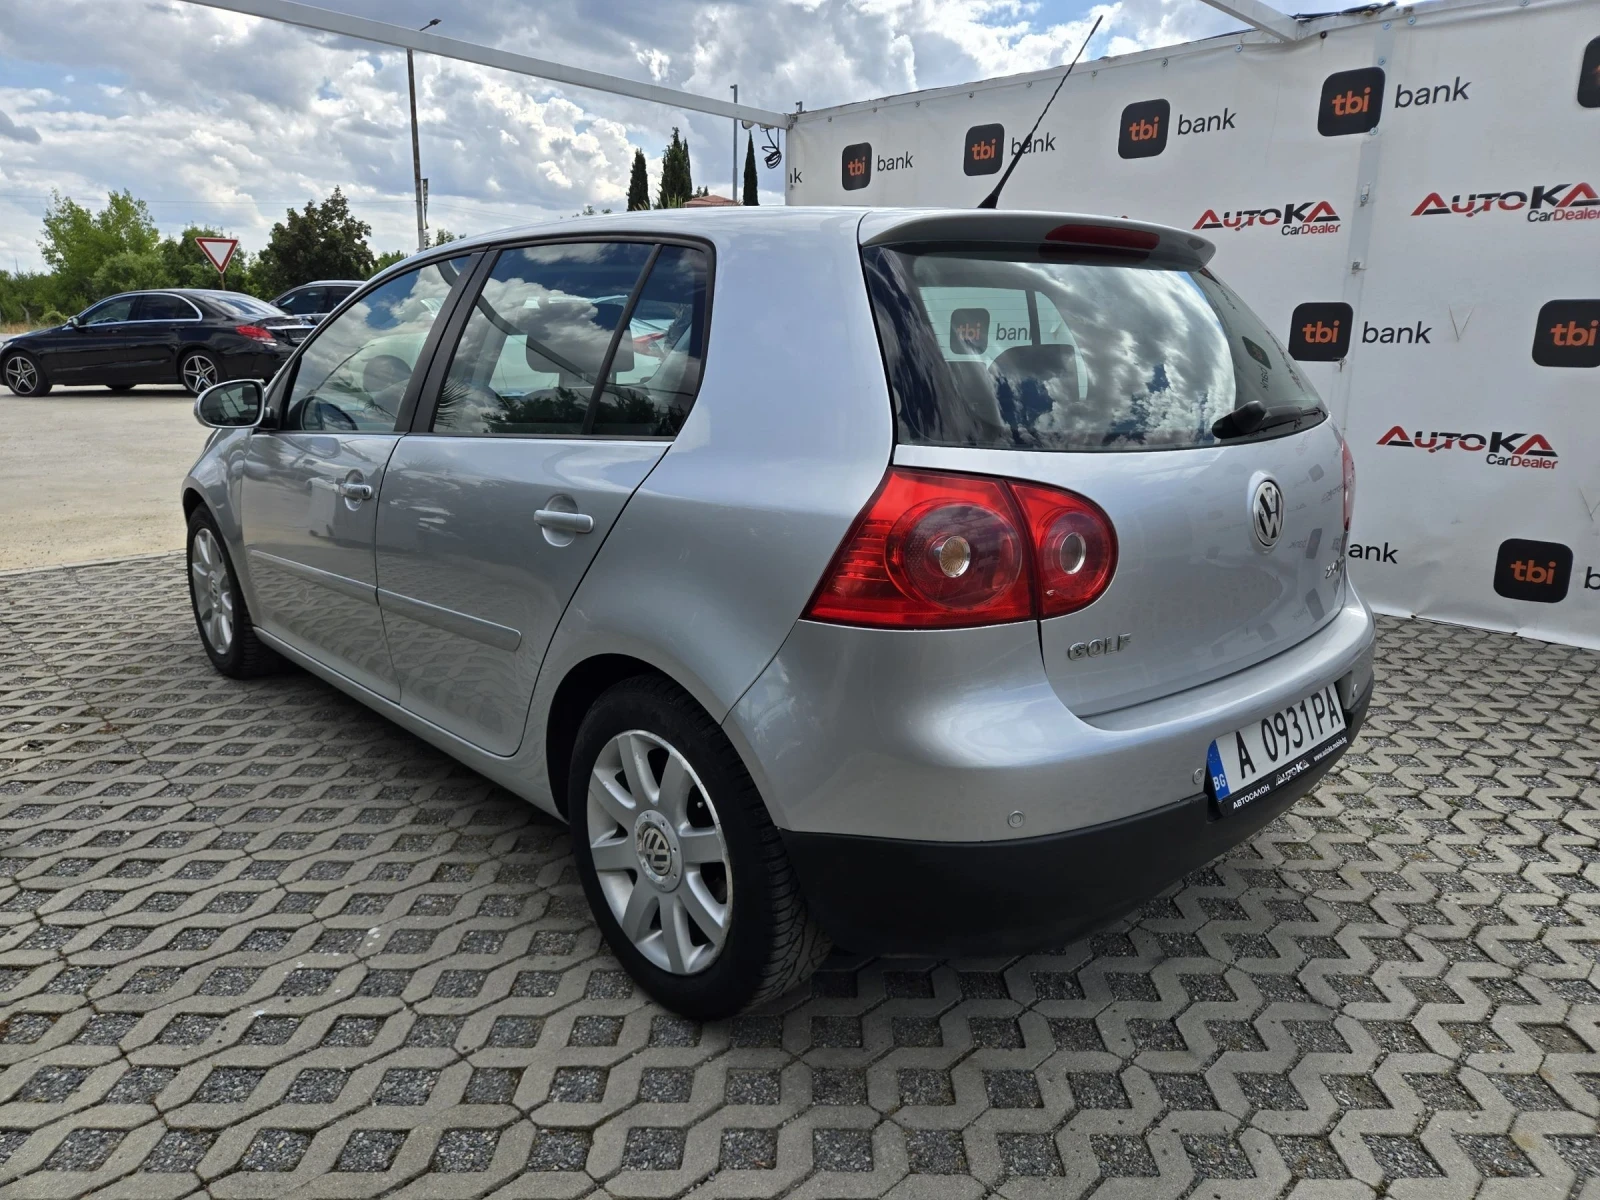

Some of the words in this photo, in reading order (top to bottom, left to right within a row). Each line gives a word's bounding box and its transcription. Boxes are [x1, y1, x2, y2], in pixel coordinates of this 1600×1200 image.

[1332, 87, 1371, 116] tbi
[1394, 76, 1471, 108] bank
[1129, 116, 1159, 141] tbi
[1178, 107, 1237, 135] bank
[972, 138, 996, 160] tbi
[848, 156, 866, 176] tbi
[877, 151, 914, 172] bank
[1527, 207, 1600, 222] CarDealer
[1281, 222, 1341, 236] CarDealer
[956, 322, 981, 340] tbi
[996, 323, 1032, 340] ban
[1302, 320, 1340, 343] tbi
[1361, 321, 1432, 344] bank
[1550, 319, 1599, 346] tbi
[1486, 453, 1558, 469] CarDealer
[1348, 542, 1398, 564] ank
[1510, 560, 1556, 585] tbi
[1067, 633, 1131, 661] GOLF
[1236, 731, 1256, 779] A
[1212, 773, 1226, 791] BG
